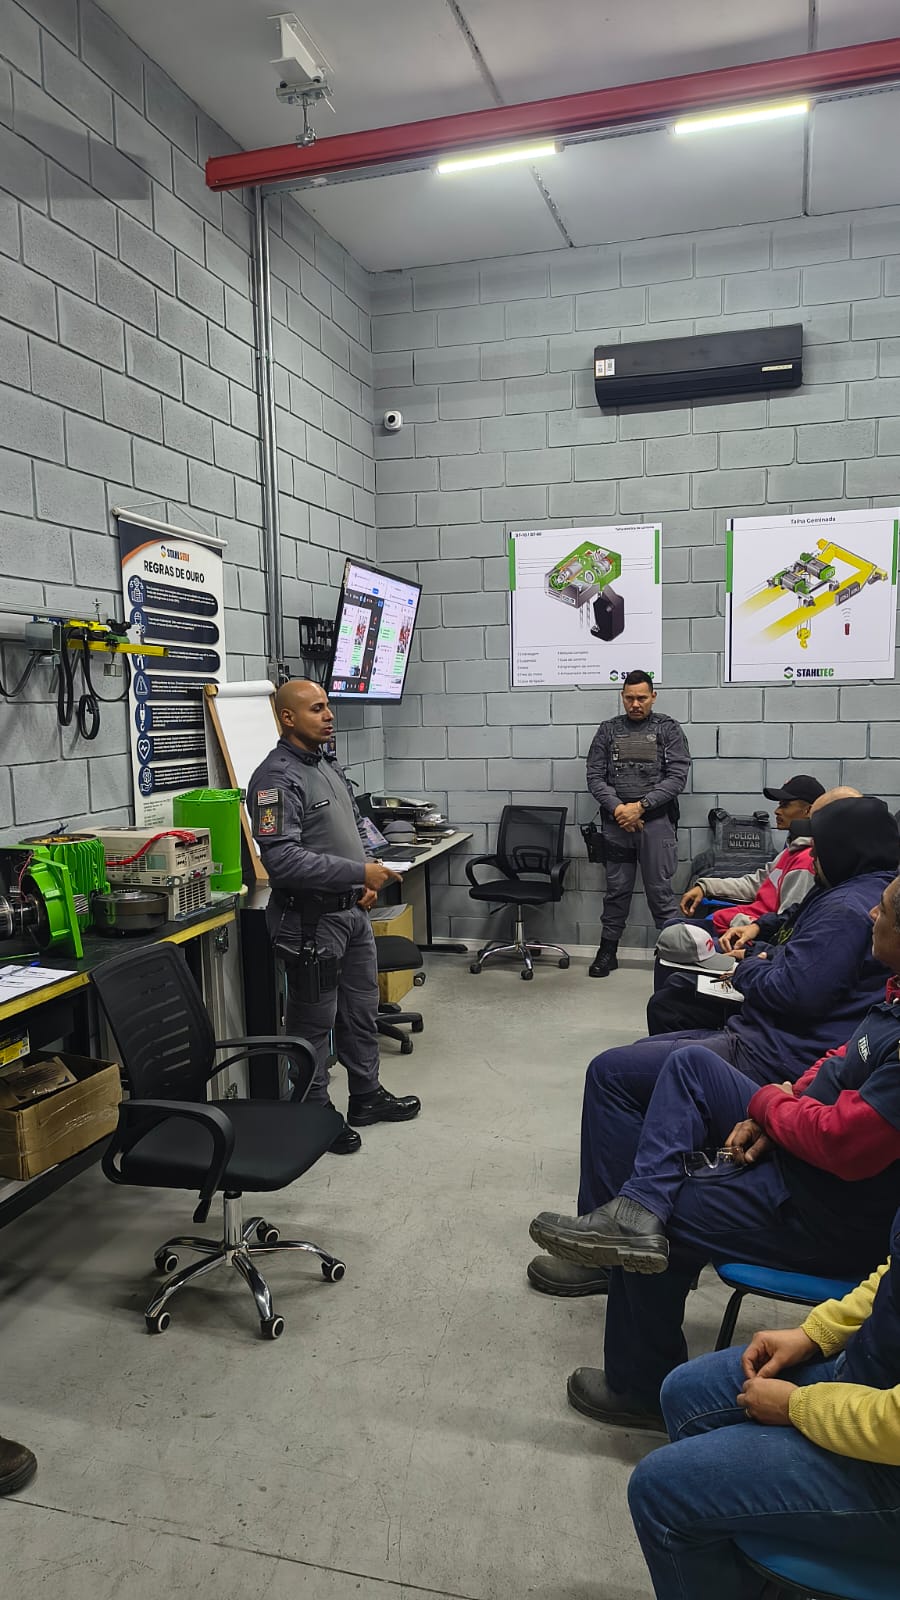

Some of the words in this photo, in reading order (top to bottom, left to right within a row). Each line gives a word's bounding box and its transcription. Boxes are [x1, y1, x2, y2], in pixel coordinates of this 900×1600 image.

[144, 560, 174, 577] REGRAS
[176, 568, 185, 579] DE
[186, 570, 205, 583] OURO
[796, 668, 834, 678] STAHLTEC
[729, 840, 760, 849] MILITAR
